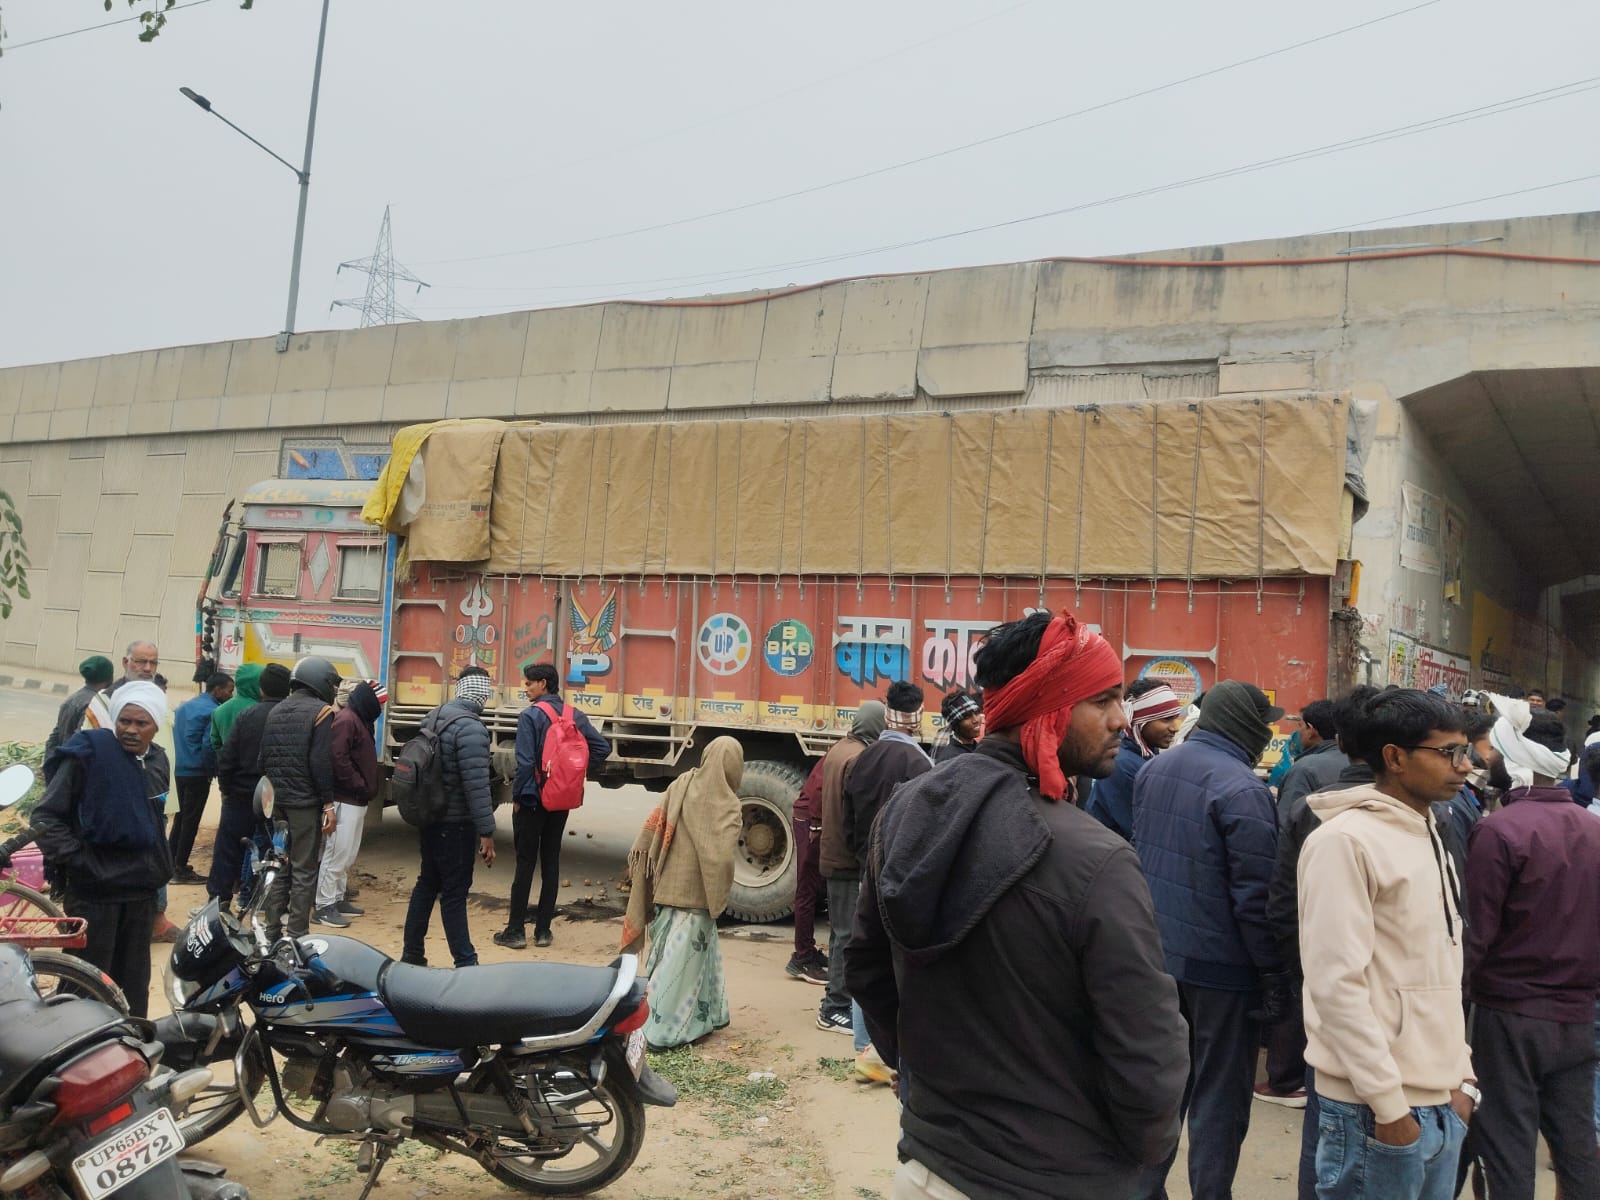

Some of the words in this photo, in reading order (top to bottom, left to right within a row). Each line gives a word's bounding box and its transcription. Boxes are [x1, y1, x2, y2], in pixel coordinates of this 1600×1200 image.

[782, 626, 798, 640] B
[514, 638, 538, 659] OUR
[715, 634, 734, 654] UP
[767, 640, 811, 656] BKB
[835, 616, 912, 688] बाबा
[781, 656, 797, 671] B
[88, 1119, 159, 1168] UP65BX
[96, 1134, 173, 1190] 0872
